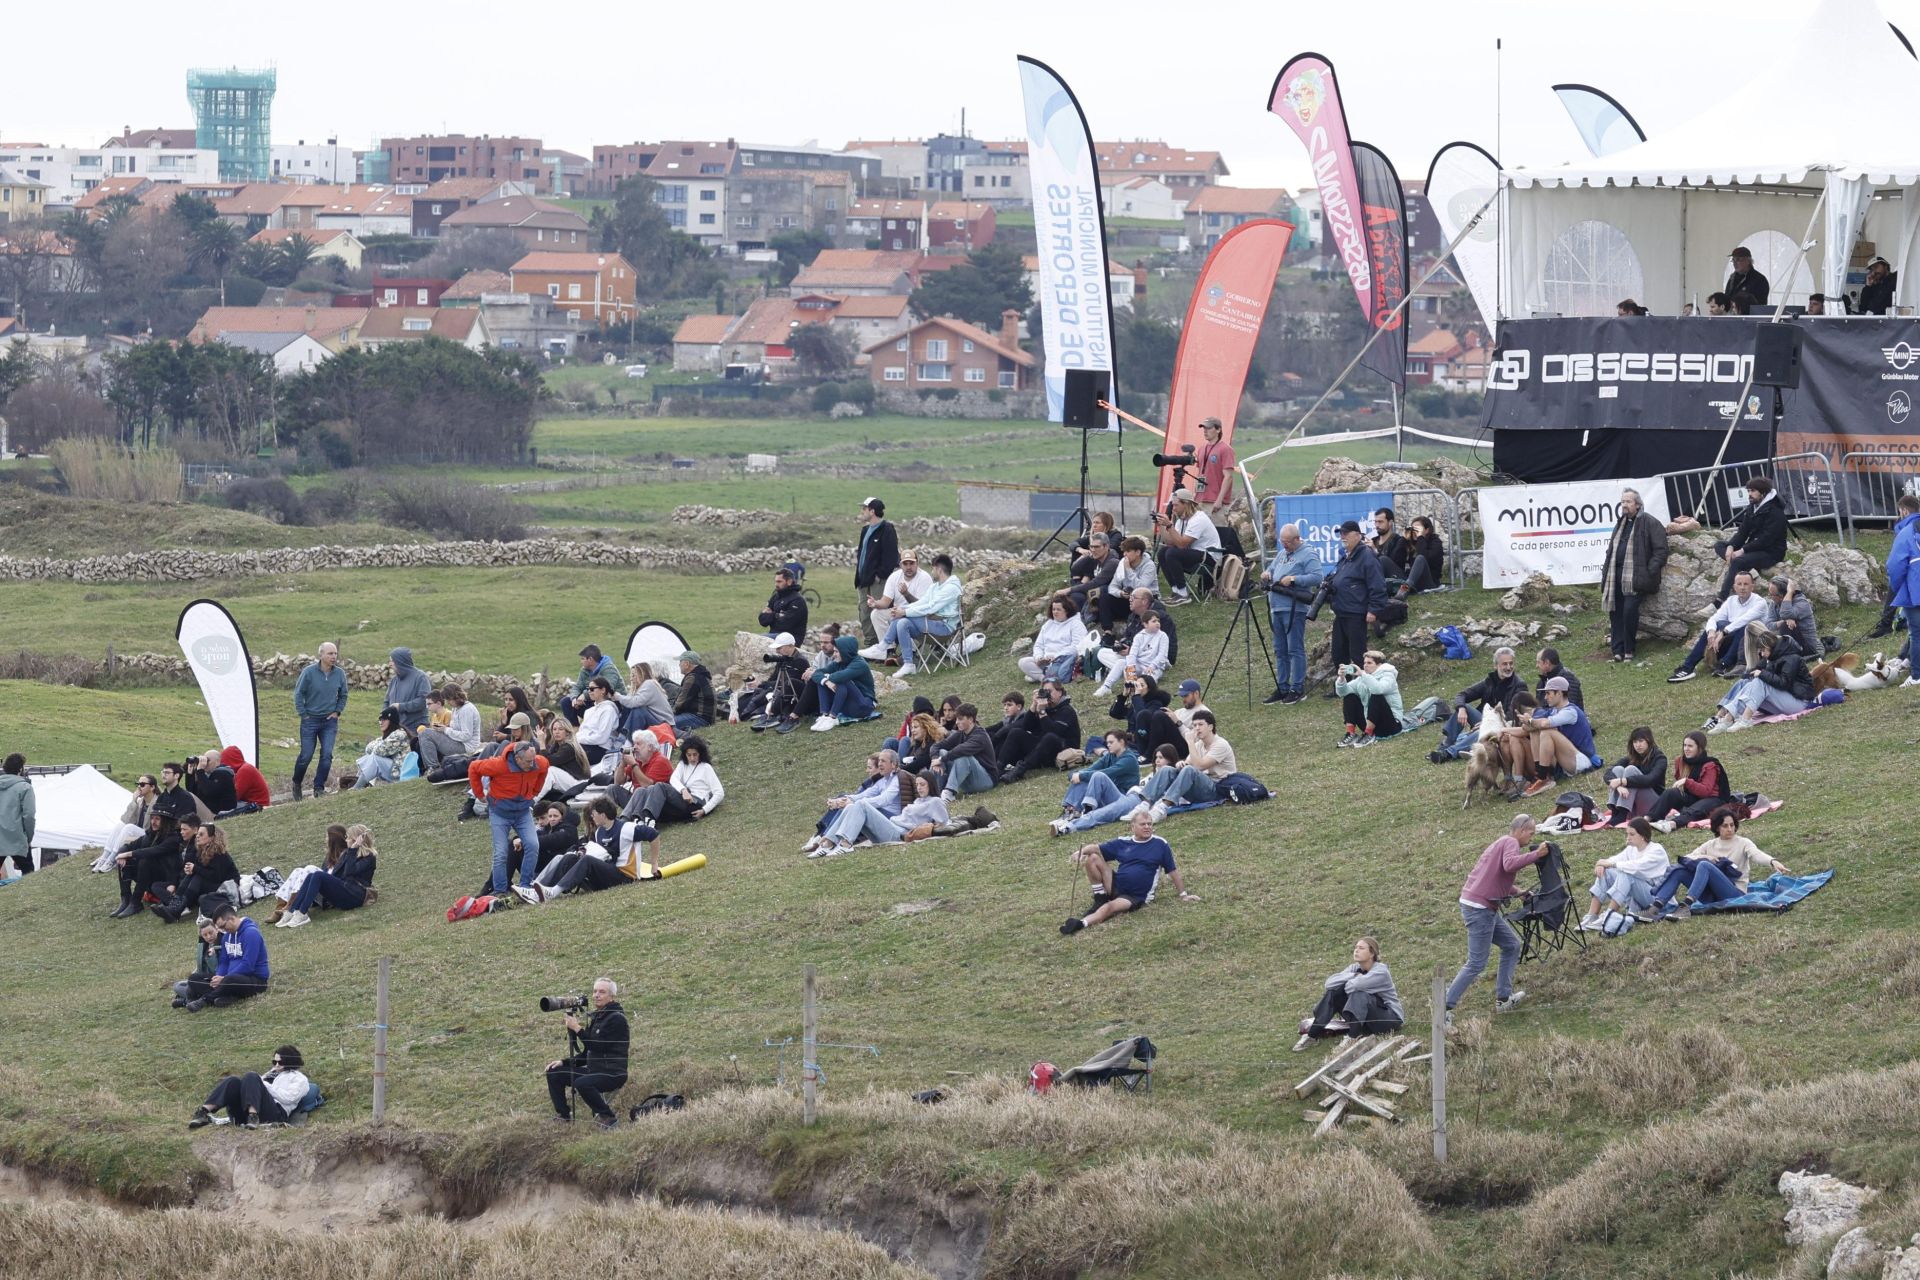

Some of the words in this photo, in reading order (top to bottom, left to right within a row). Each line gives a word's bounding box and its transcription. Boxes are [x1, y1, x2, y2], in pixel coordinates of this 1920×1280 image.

[1226, 292, 1261, 308] GOBIERNO
[1222, 306, 1261, 323] CANTABRIA
[1894, 352, 1909, 360] MINI
[1541, 353, 1755, 383] OBSESSION
[1511, 541, 1537, 551] Cada
[1539, 540, 1575, 553] persona
[1578, 539, 1588, 547] es
[1591, 538, 1602, 547] un
